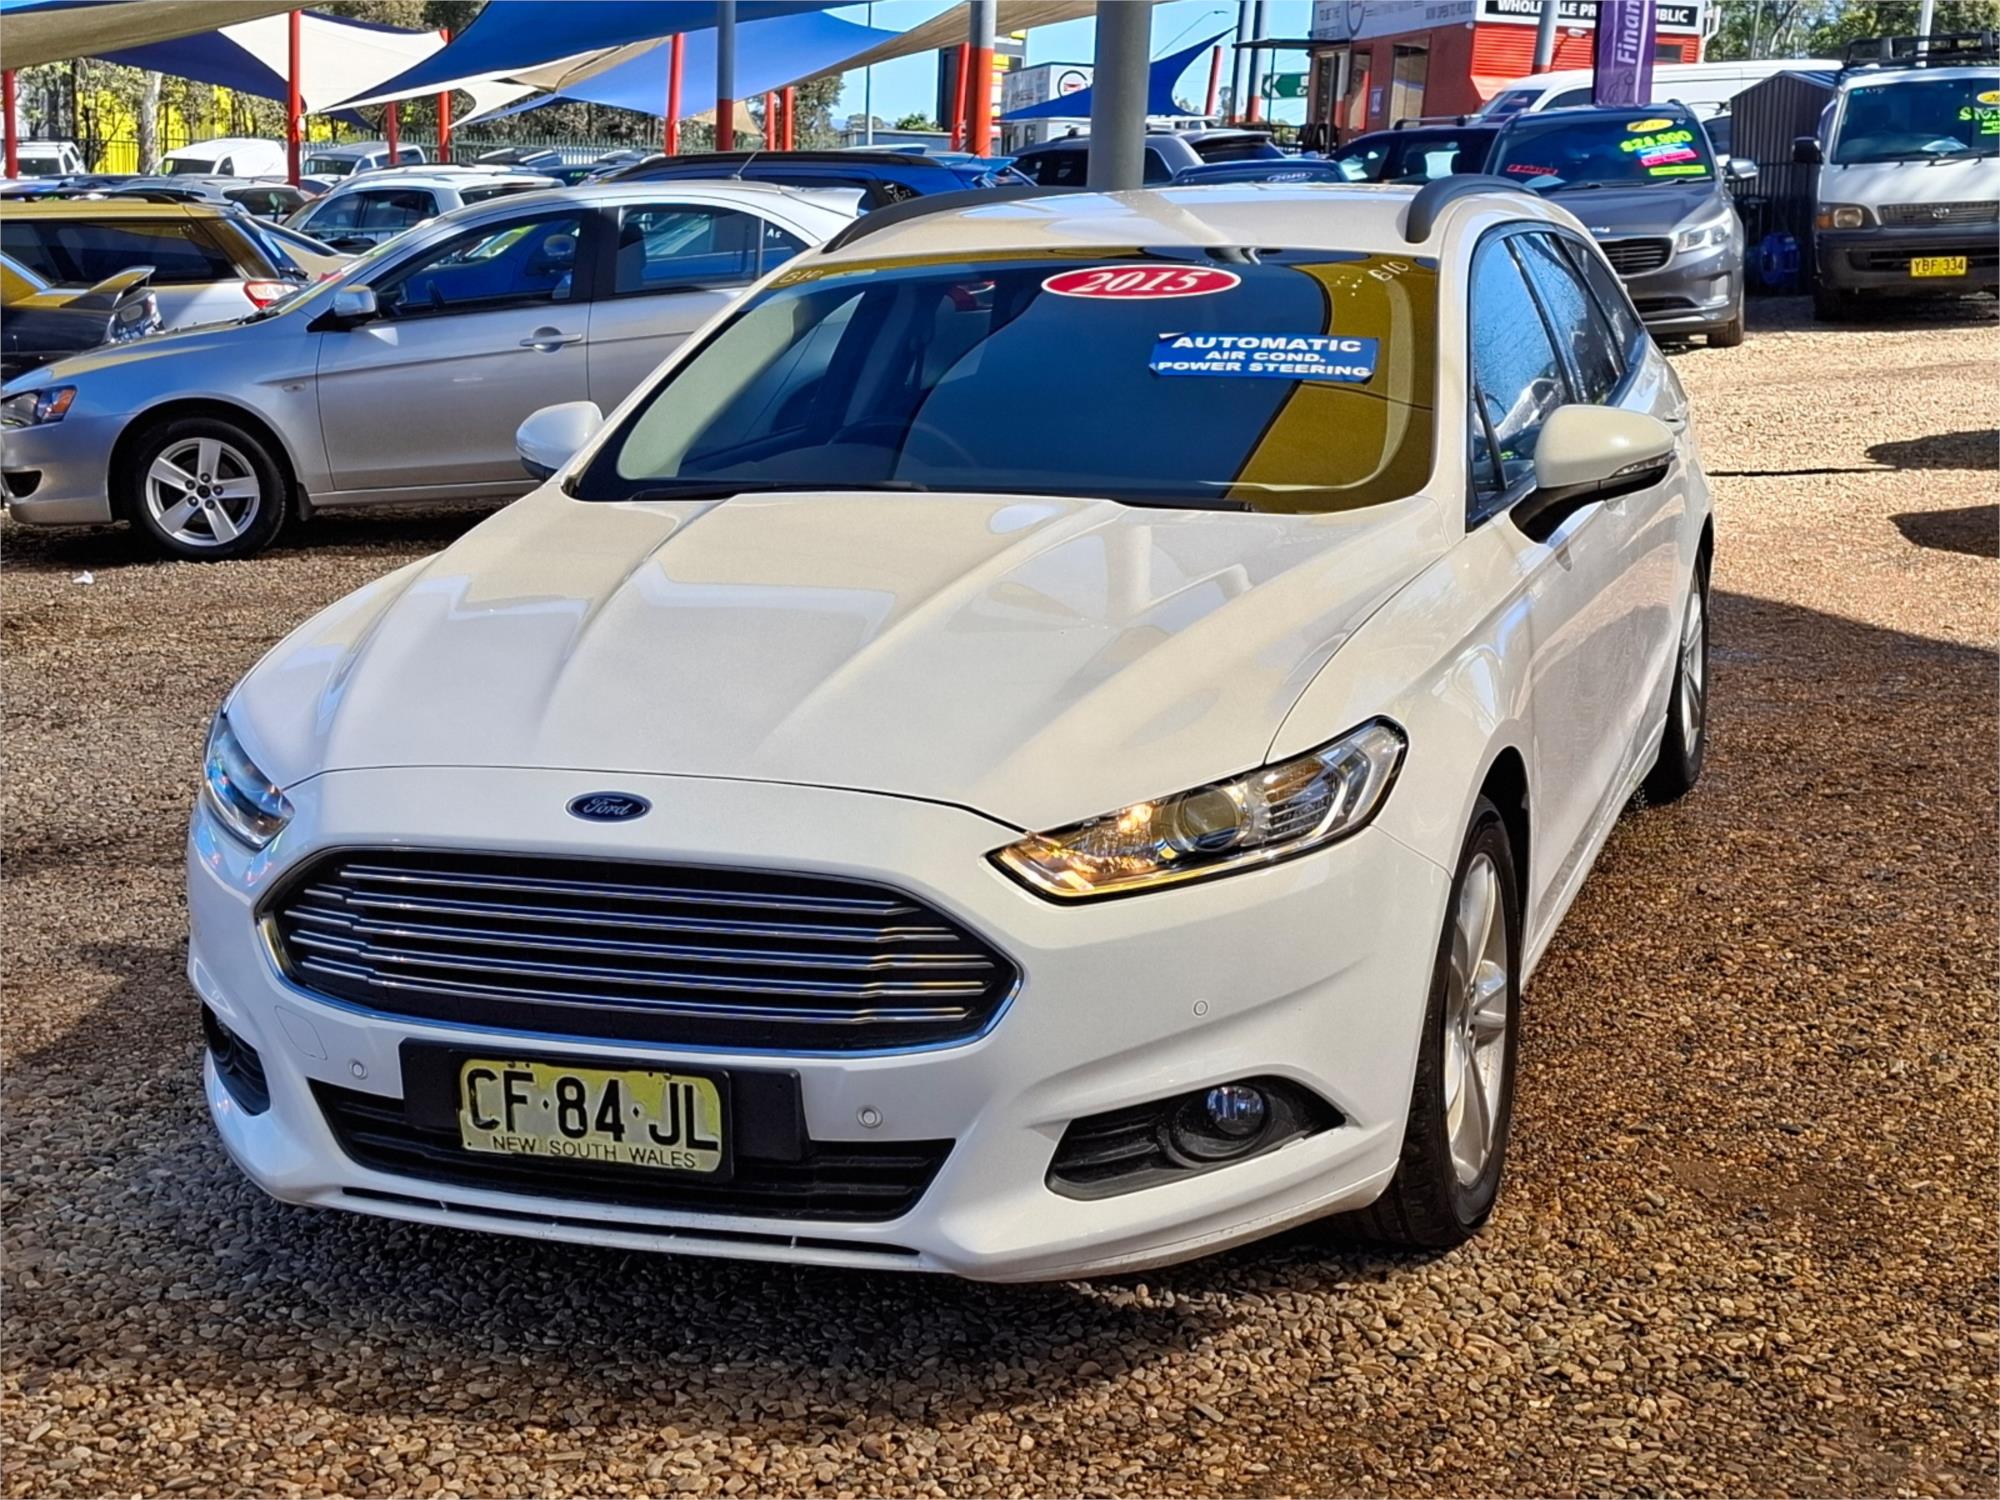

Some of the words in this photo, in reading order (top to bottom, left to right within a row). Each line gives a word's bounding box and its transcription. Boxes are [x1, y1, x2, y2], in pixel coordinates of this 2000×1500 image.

[1498, 0, 1577, 16] WHOLLE
[1656, 8, 1689, 23] BLIC
[1616, 0, 1641, 65] Finan
[1913, 259, 1938, 273] YBF
[1942, 257, 1964, 271] 334
[1067, 270, 1211, 293] 2015
[1170, 336, 1362, 352] AUTOMATIC
[1205, 350, 1246, 361] AIR
[1252, 351, 1327, 363] COND.
[1157, 361, 1242, 373] POWER
[1248, 361, 1373, 378] STEERING
[582, 797, 634, 816] Ford
[492, 1135, 538, 1154] NEW
[549, 1140, 618, 1164] SOUTH
[629, 1146, 697, 1169] WALES
